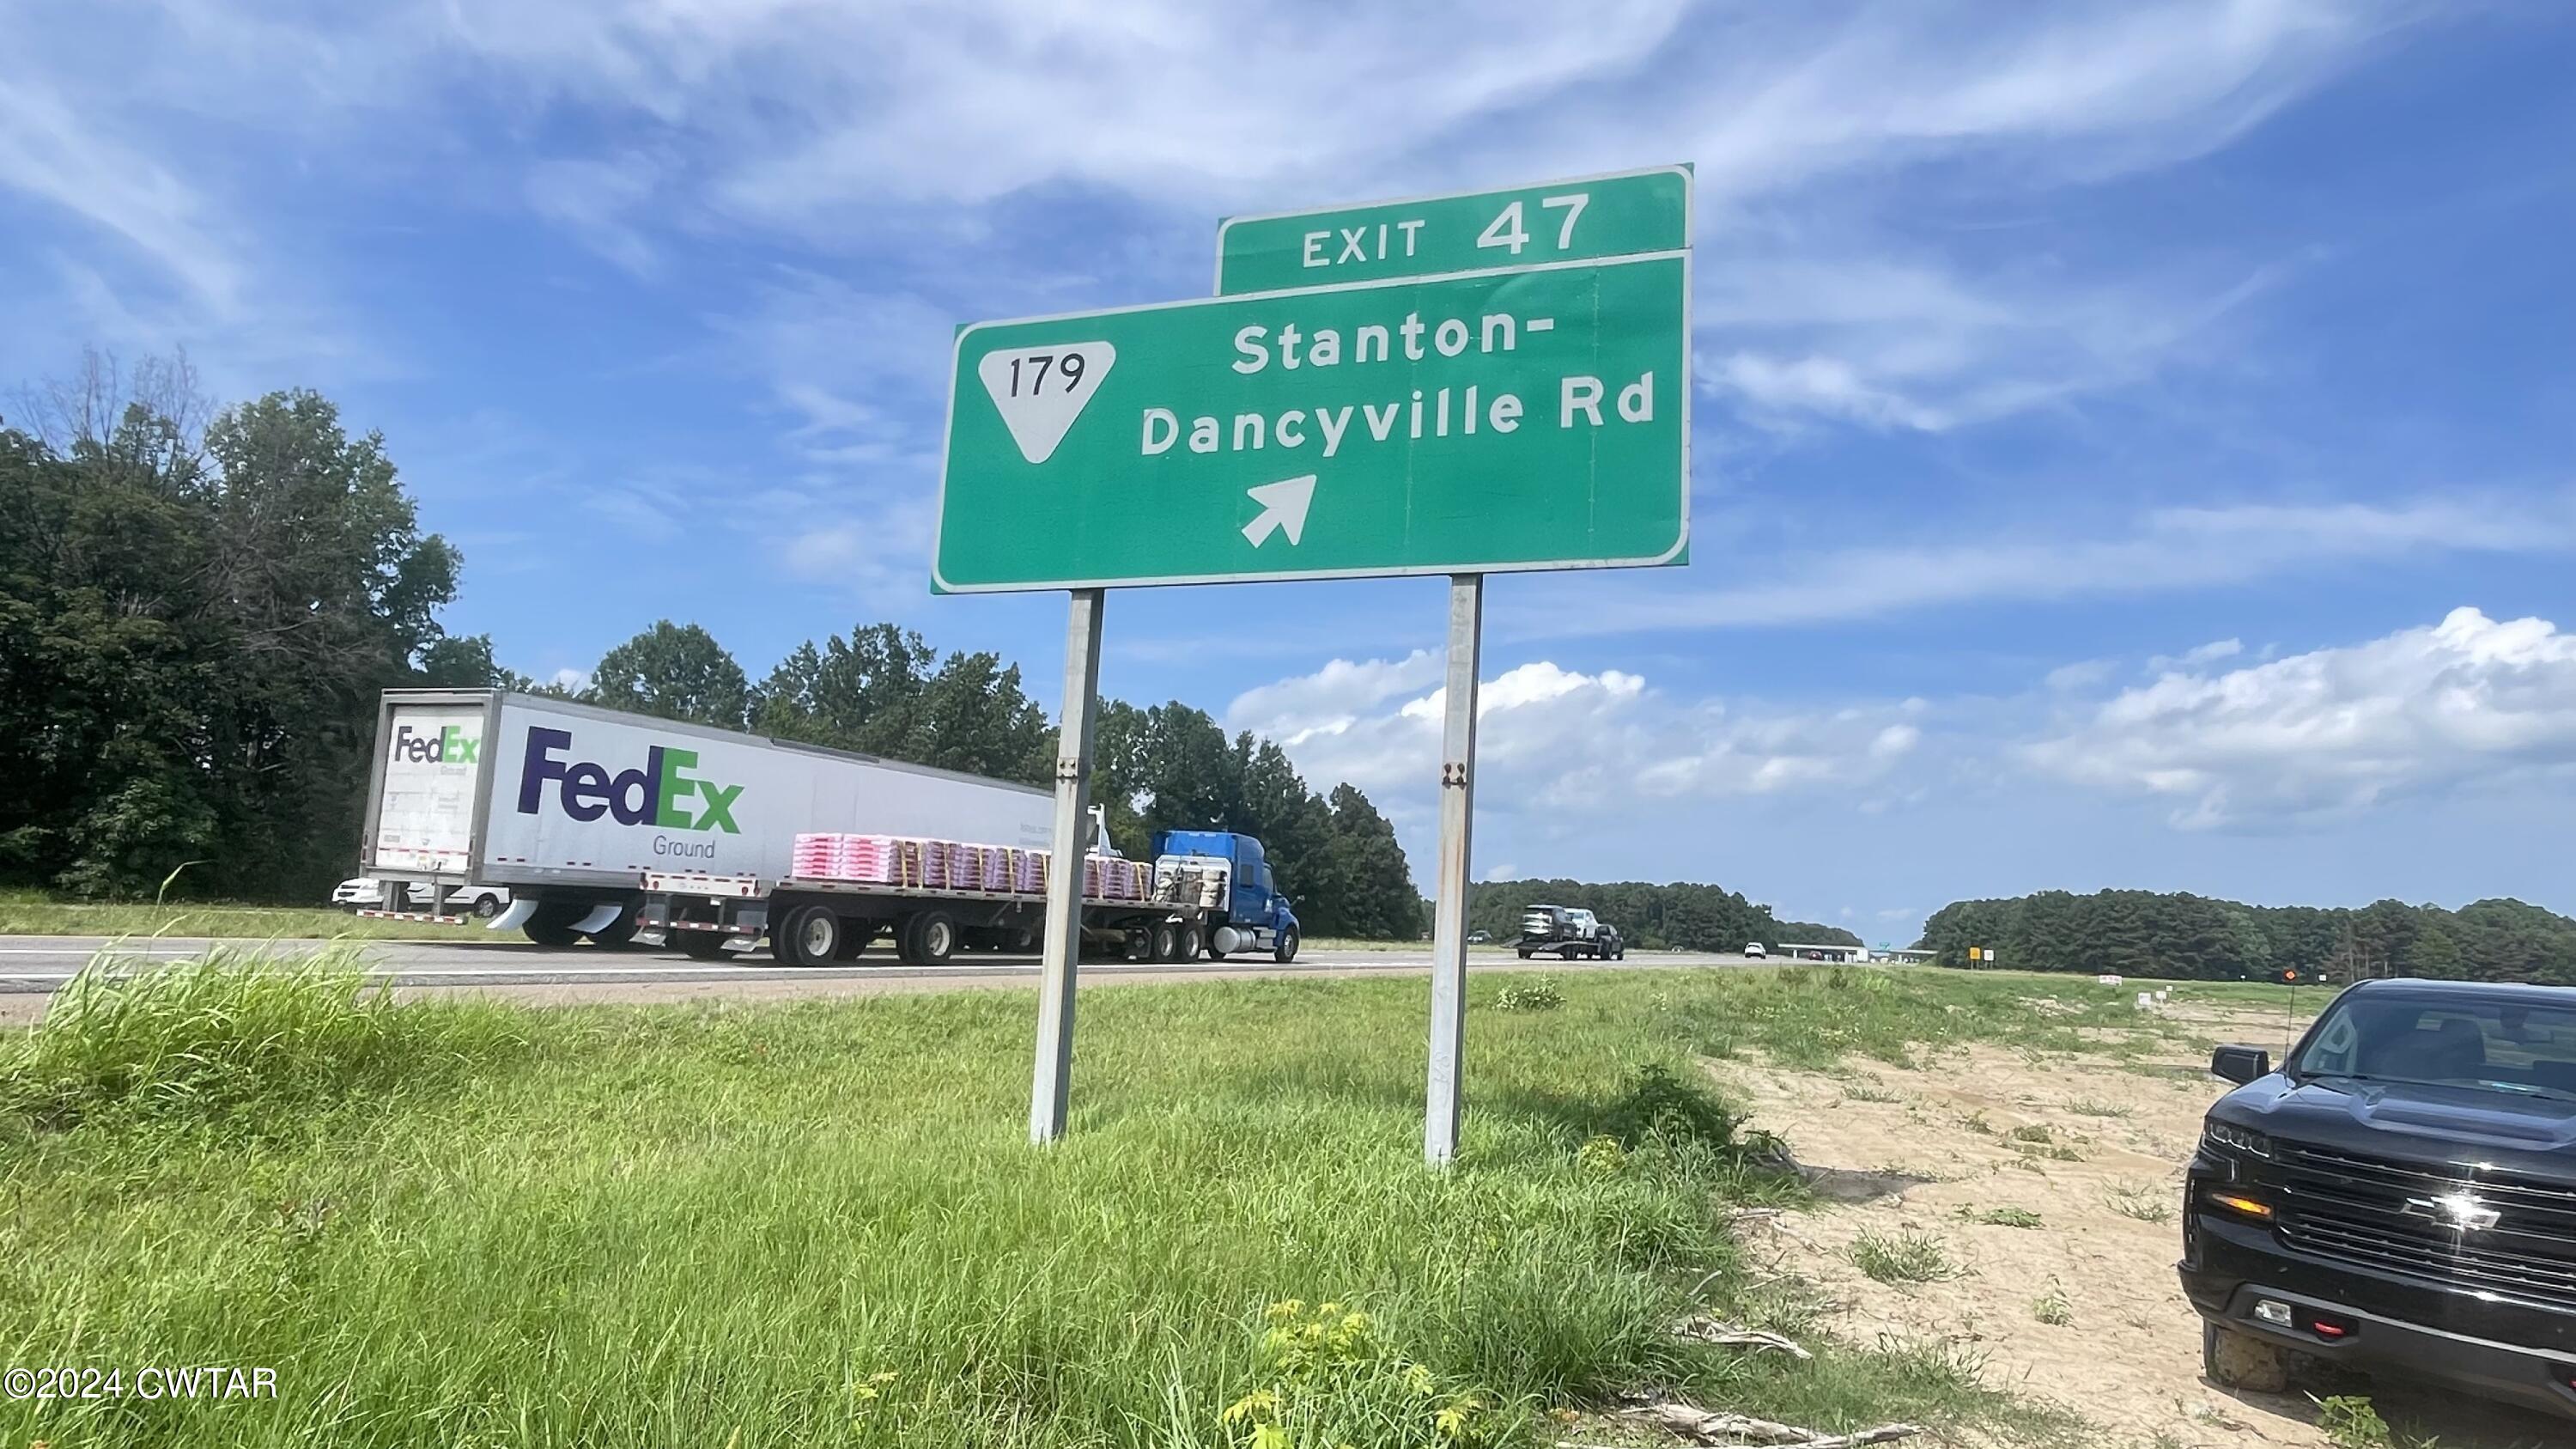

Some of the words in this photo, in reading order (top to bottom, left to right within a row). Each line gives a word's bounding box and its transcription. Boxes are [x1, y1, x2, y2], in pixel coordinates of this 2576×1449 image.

[1303, 221, 1425, 269] EXIT
[1477, 194, 1589, 254] 47
[1009, 353, 1085, 397] 179
[1231, 313, 1555, 375] Stanton-
[1141, 386, 1524, 458] Dancyville
[1560, 372, 1656, 429] Rd
[395, 726, 480, 763] FedEx
[517, 726, 745, 834] FedEx
[653, 835, 715, 859] Ground
